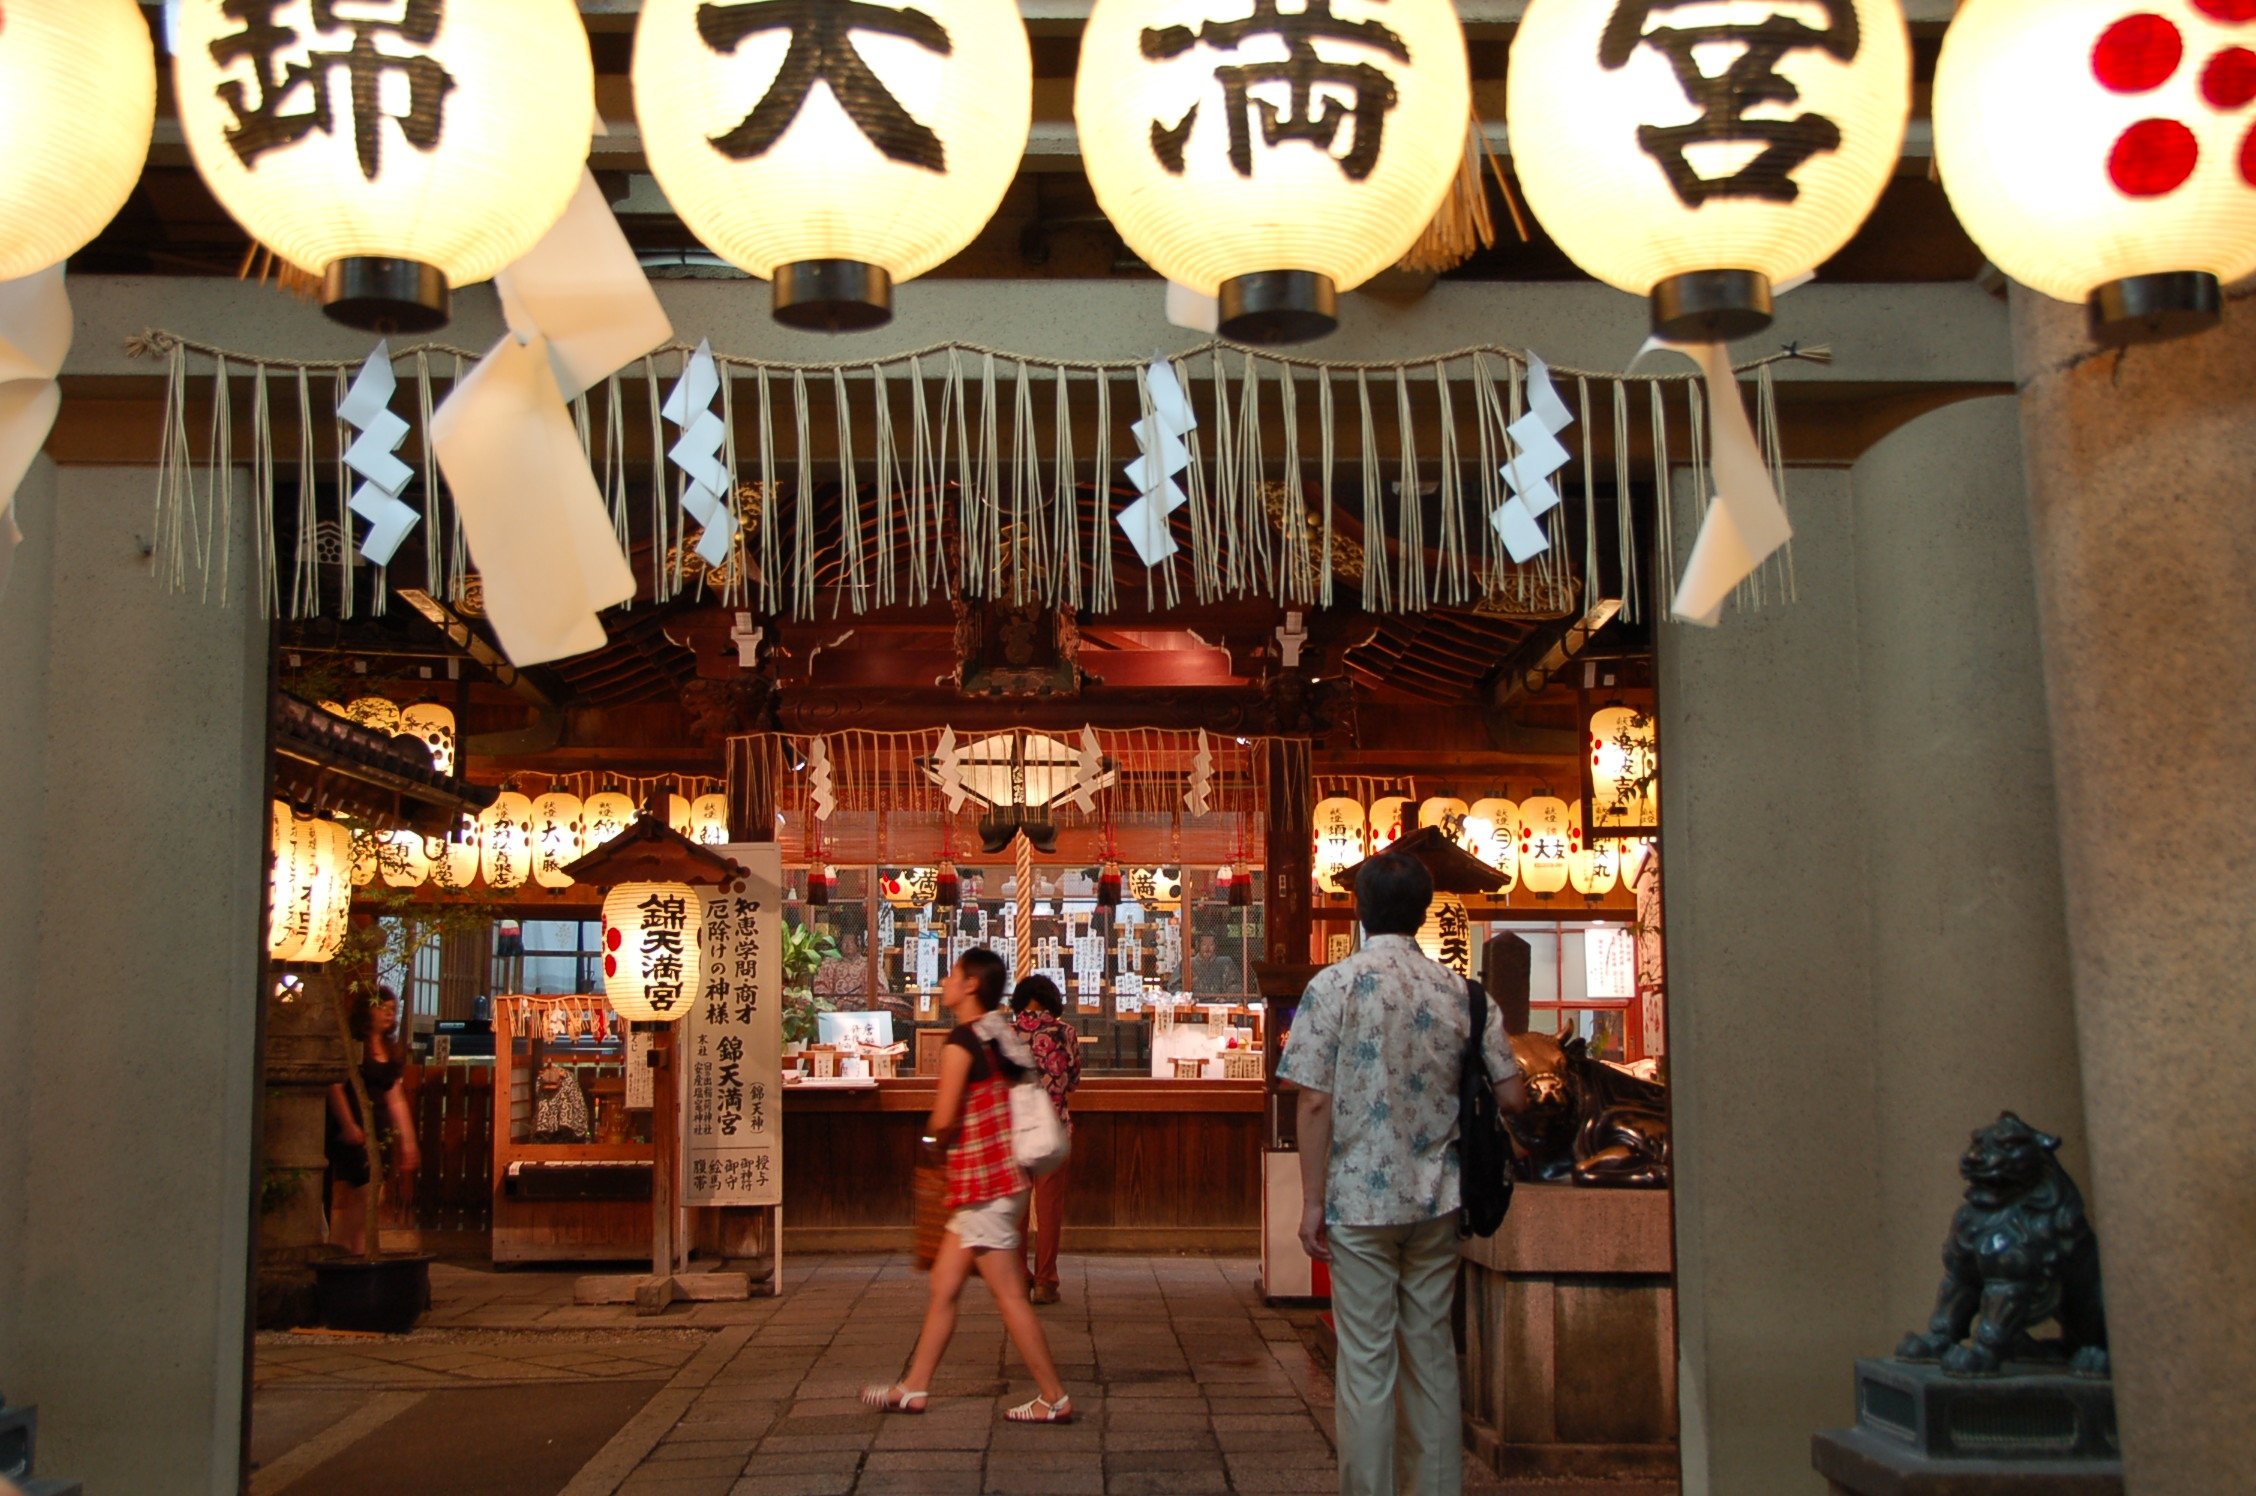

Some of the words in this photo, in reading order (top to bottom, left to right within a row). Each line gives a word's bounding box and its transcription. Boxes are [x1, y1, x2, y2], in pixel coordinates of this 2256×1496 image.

[208, 0, 458, 184] 錦
[1598, 0, 1863, 210] 宮
[637, 893, 688, 1012] 錦天満宮
[705, 899, 732, 1025] 厄除けの神様
[716, 1035, 744, 1136] 錦天満宮
[709, 1159, 724, 1191] 絵馬
[725, 1159, 740, 1191] 御守
